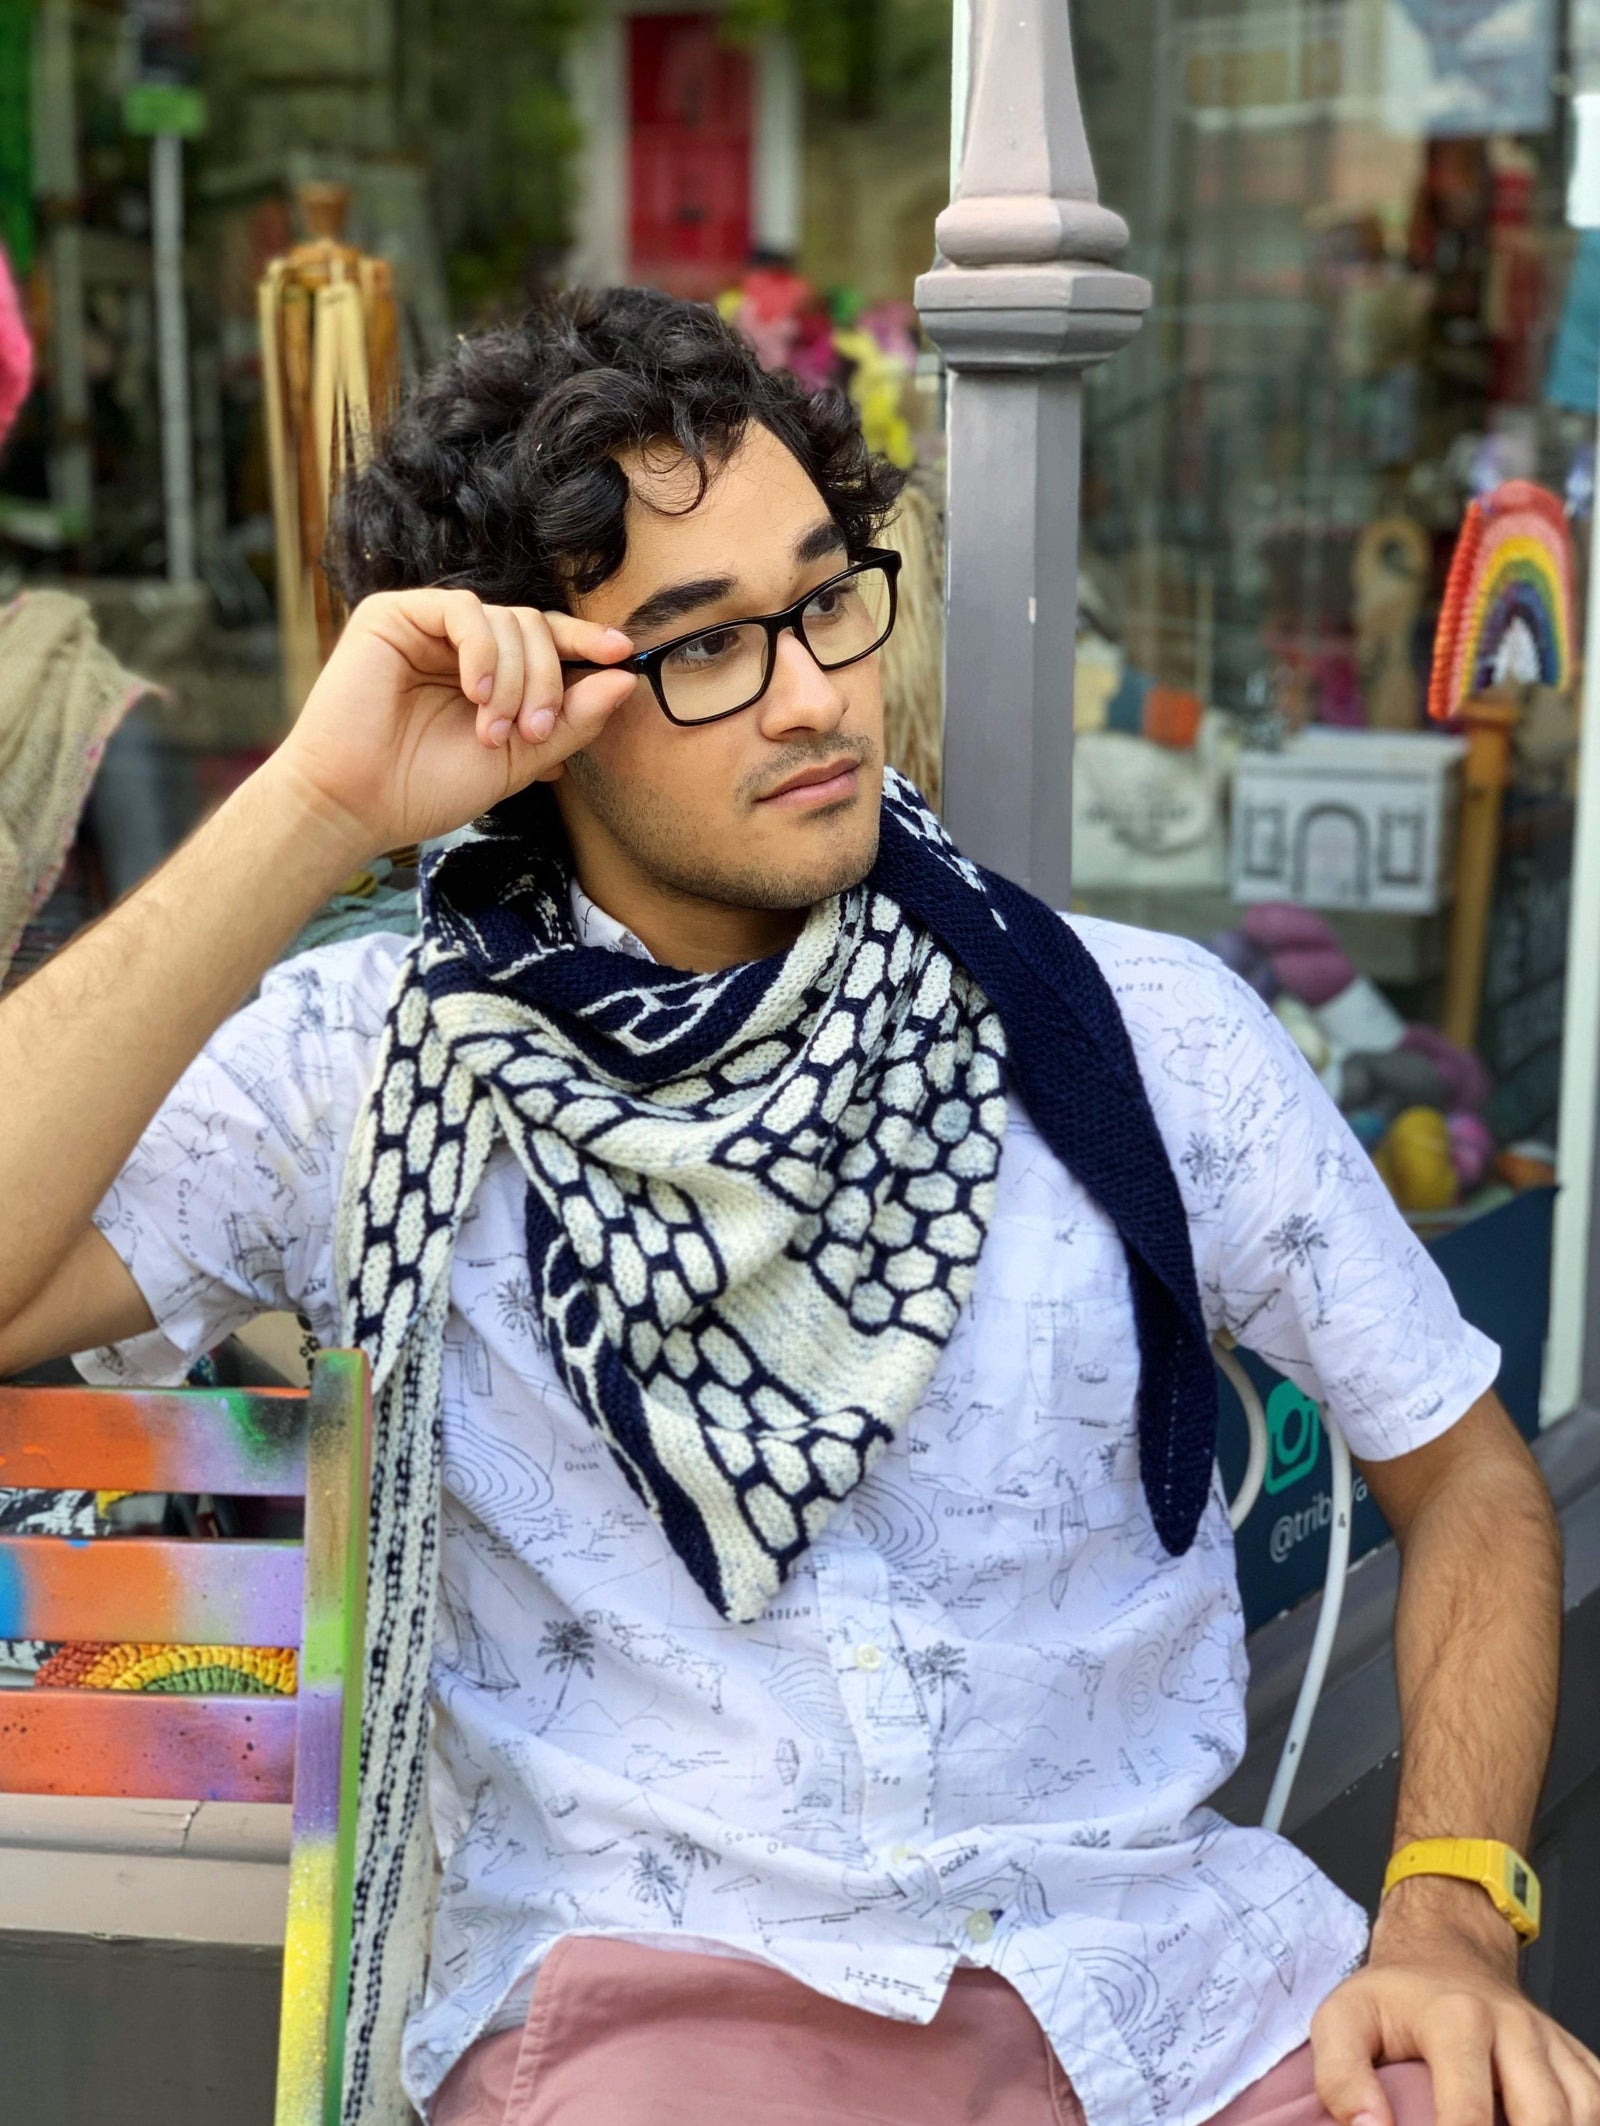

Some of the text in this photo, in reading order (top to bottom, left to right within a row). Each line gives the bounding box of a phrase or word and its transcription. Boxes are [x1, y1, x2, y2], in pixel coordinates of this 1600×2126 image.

[871, 1769, 901, 1786] Sea
[939, 1844, 980, 1878] OCEAN
[1156, 1922, 1191, 1954] Ocean
